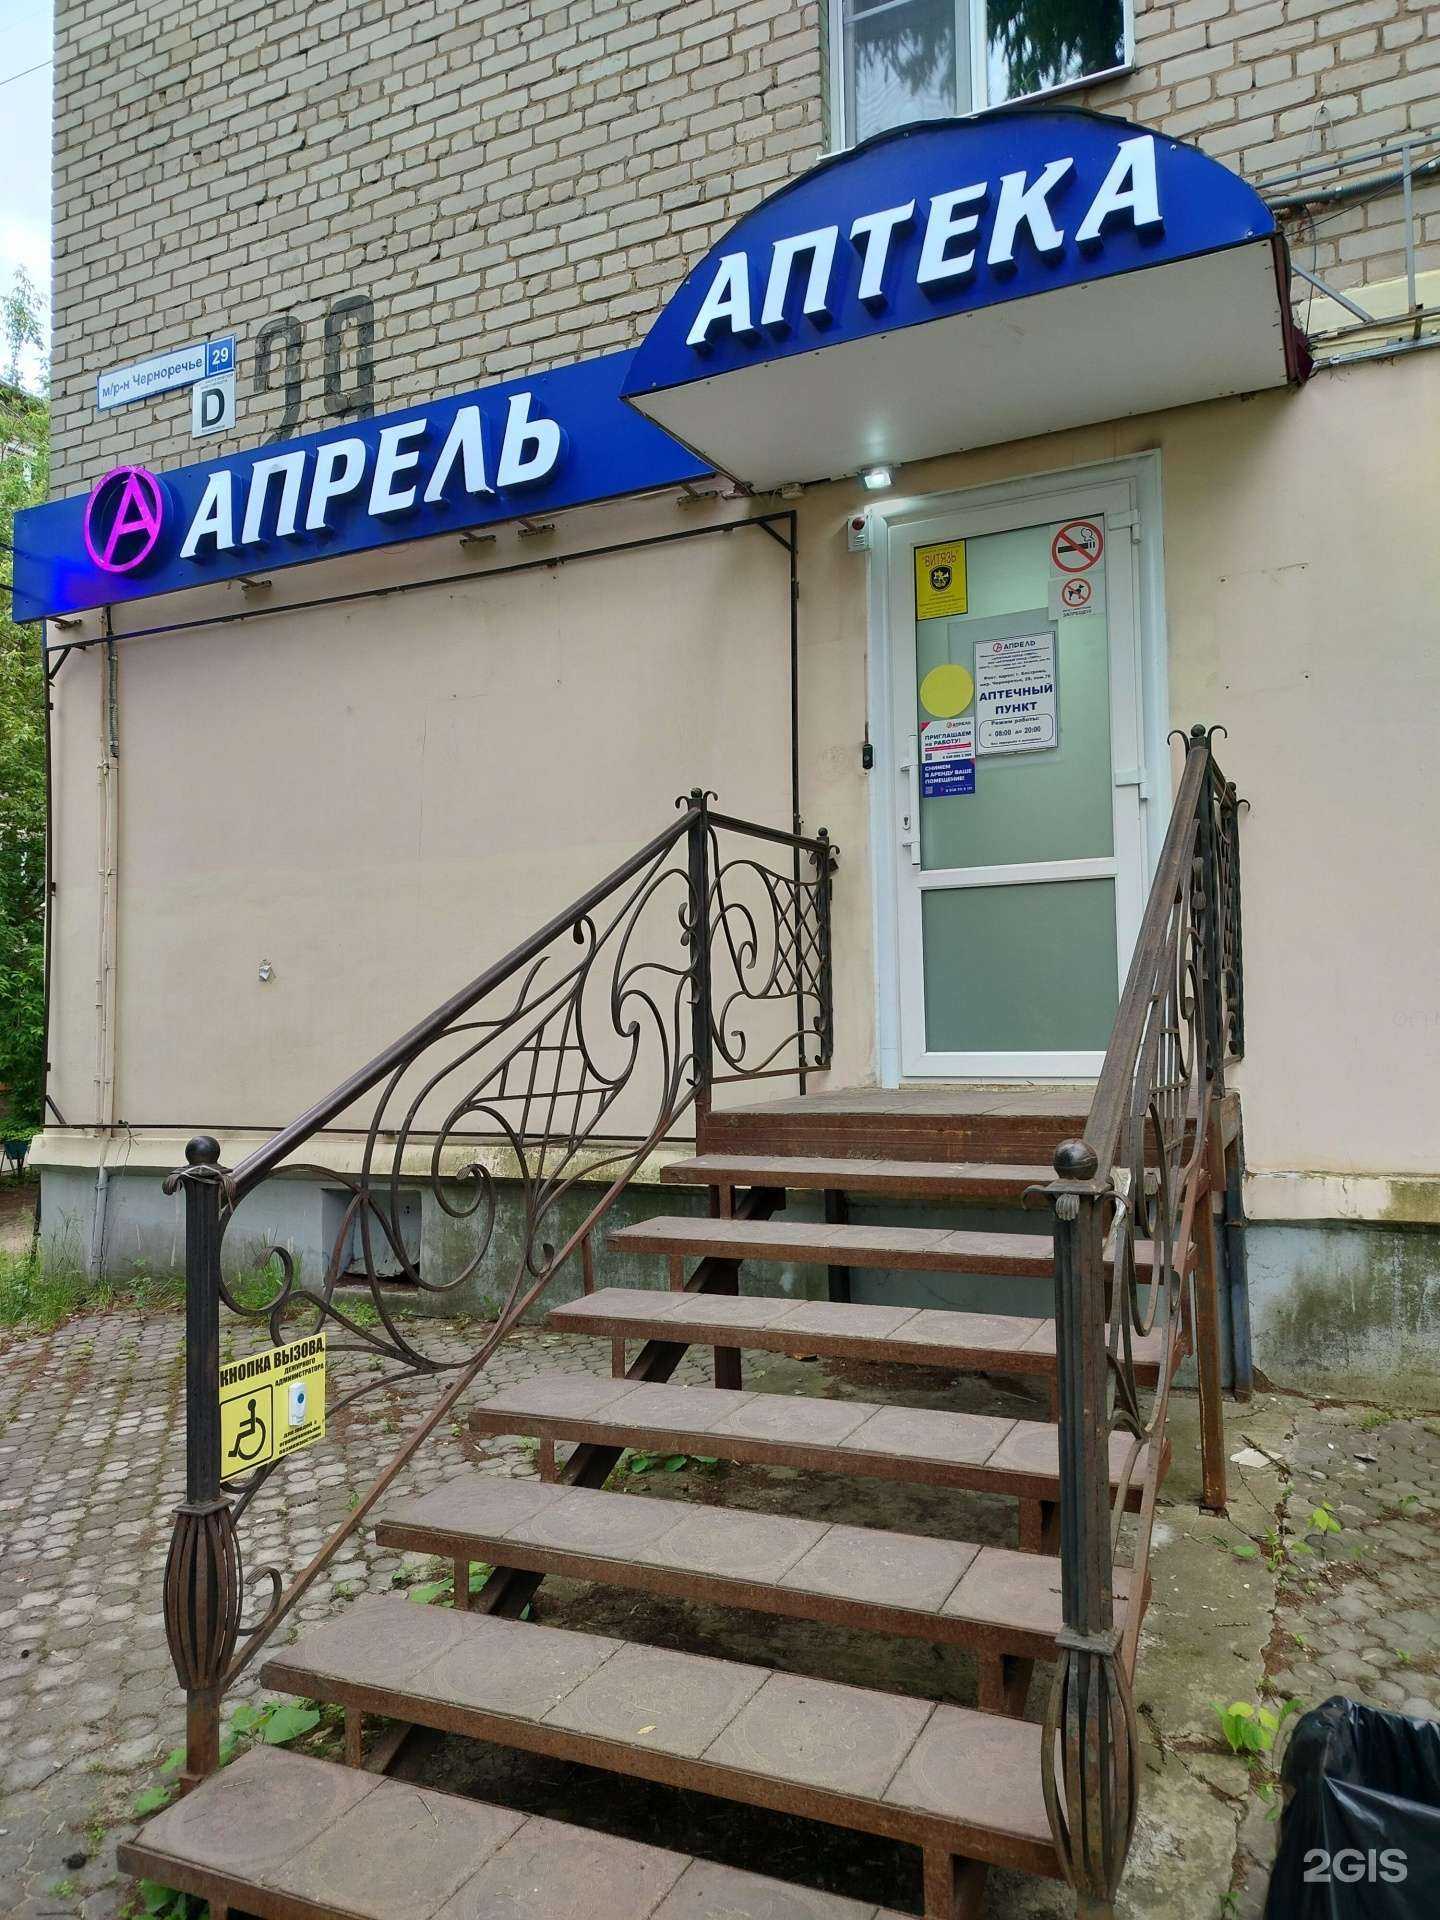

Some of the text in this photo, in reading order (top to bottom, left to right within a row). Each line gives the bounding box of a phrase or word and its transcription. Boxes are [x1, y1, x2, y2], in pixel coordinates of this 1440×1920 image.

[686, 135, 1163, 346] АПТЕКА
[212, 347, 229, 365] 29
[102, 380, 130, 397] м/р-н
[133, 358, 202, 386] Черноречье
[201, 388, 225, 428] D
[180, 392, 561, 559] АПРЕЛЬ
[980, 683, 1053, 701] АПТЕЧНЫЙ
[995, 702, 1037, 714] ПУНКТ
[925, 730, 971, 740] ПРИГЛАШАЕМ
[994, 729, 1012, 737] 08:00
[1024, 726, 1041, 734] 20:00
[220, 1337, 324, 1387] КНОПКА ВЫЗОВА
